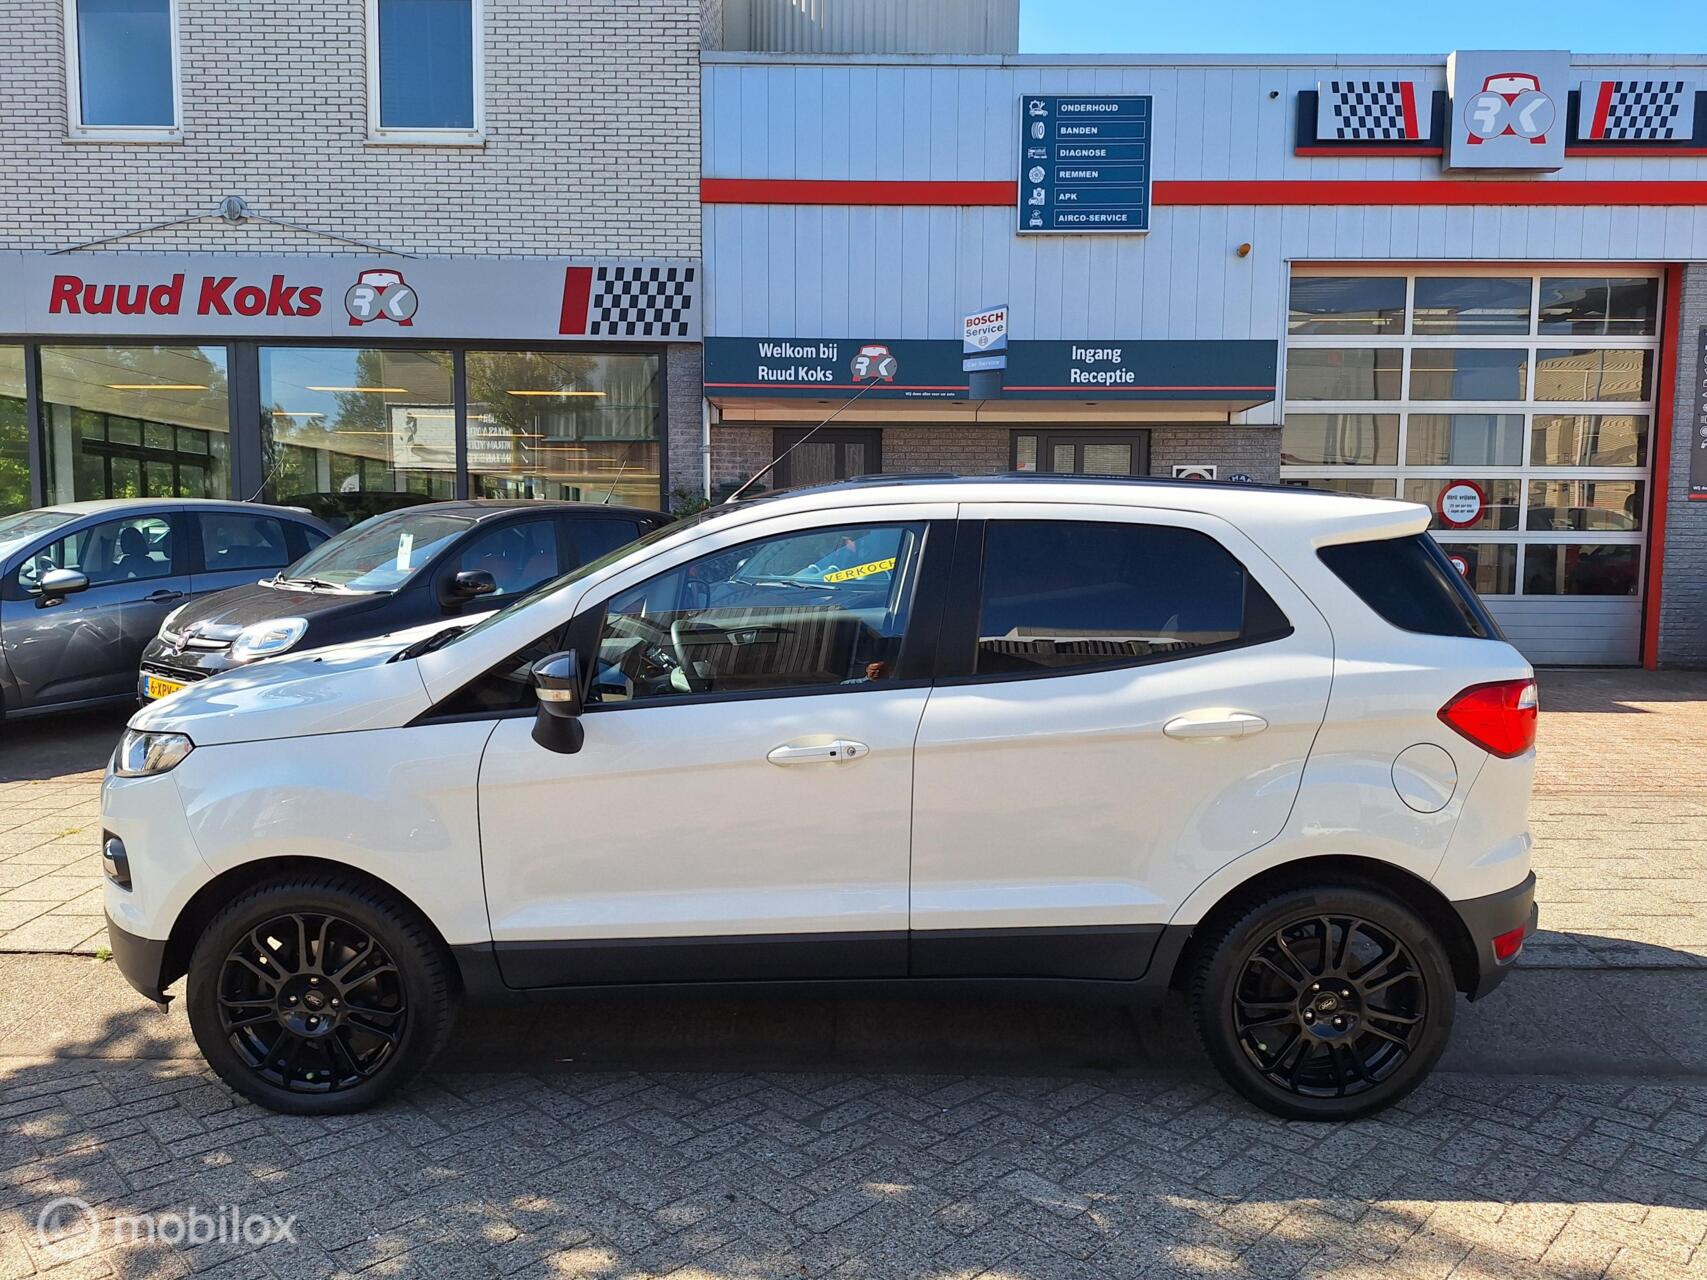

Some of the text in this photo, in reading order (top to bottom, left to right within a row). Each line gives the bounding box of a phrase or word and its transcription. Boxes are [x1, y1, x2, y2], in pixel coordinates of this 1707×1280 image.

[1060, 104, 1119, 112] ONDERHOUD
[1060, 126, 1098, 135] BANDEN
[1059, 149, 1107, 157] DIAGNOSE
[1059, 170, 1099, 178] REMMEN
[1058, 192, 1078, 200] APK
[1058, 213, 1128, 222] AIRCO-SERVICE
[49, 274, 323, 317] Ruud Koks
[966, 311, 1004, 328] BOSCH
[965, 324, 1004, 337] Service
[758, 342, 838, 362] Welkom bij
[1072, 345, 1122, 364] Ingang
[758, 365, 834, 382] Ruud Koks
[1070, 367, 1135, 387] Receptie
